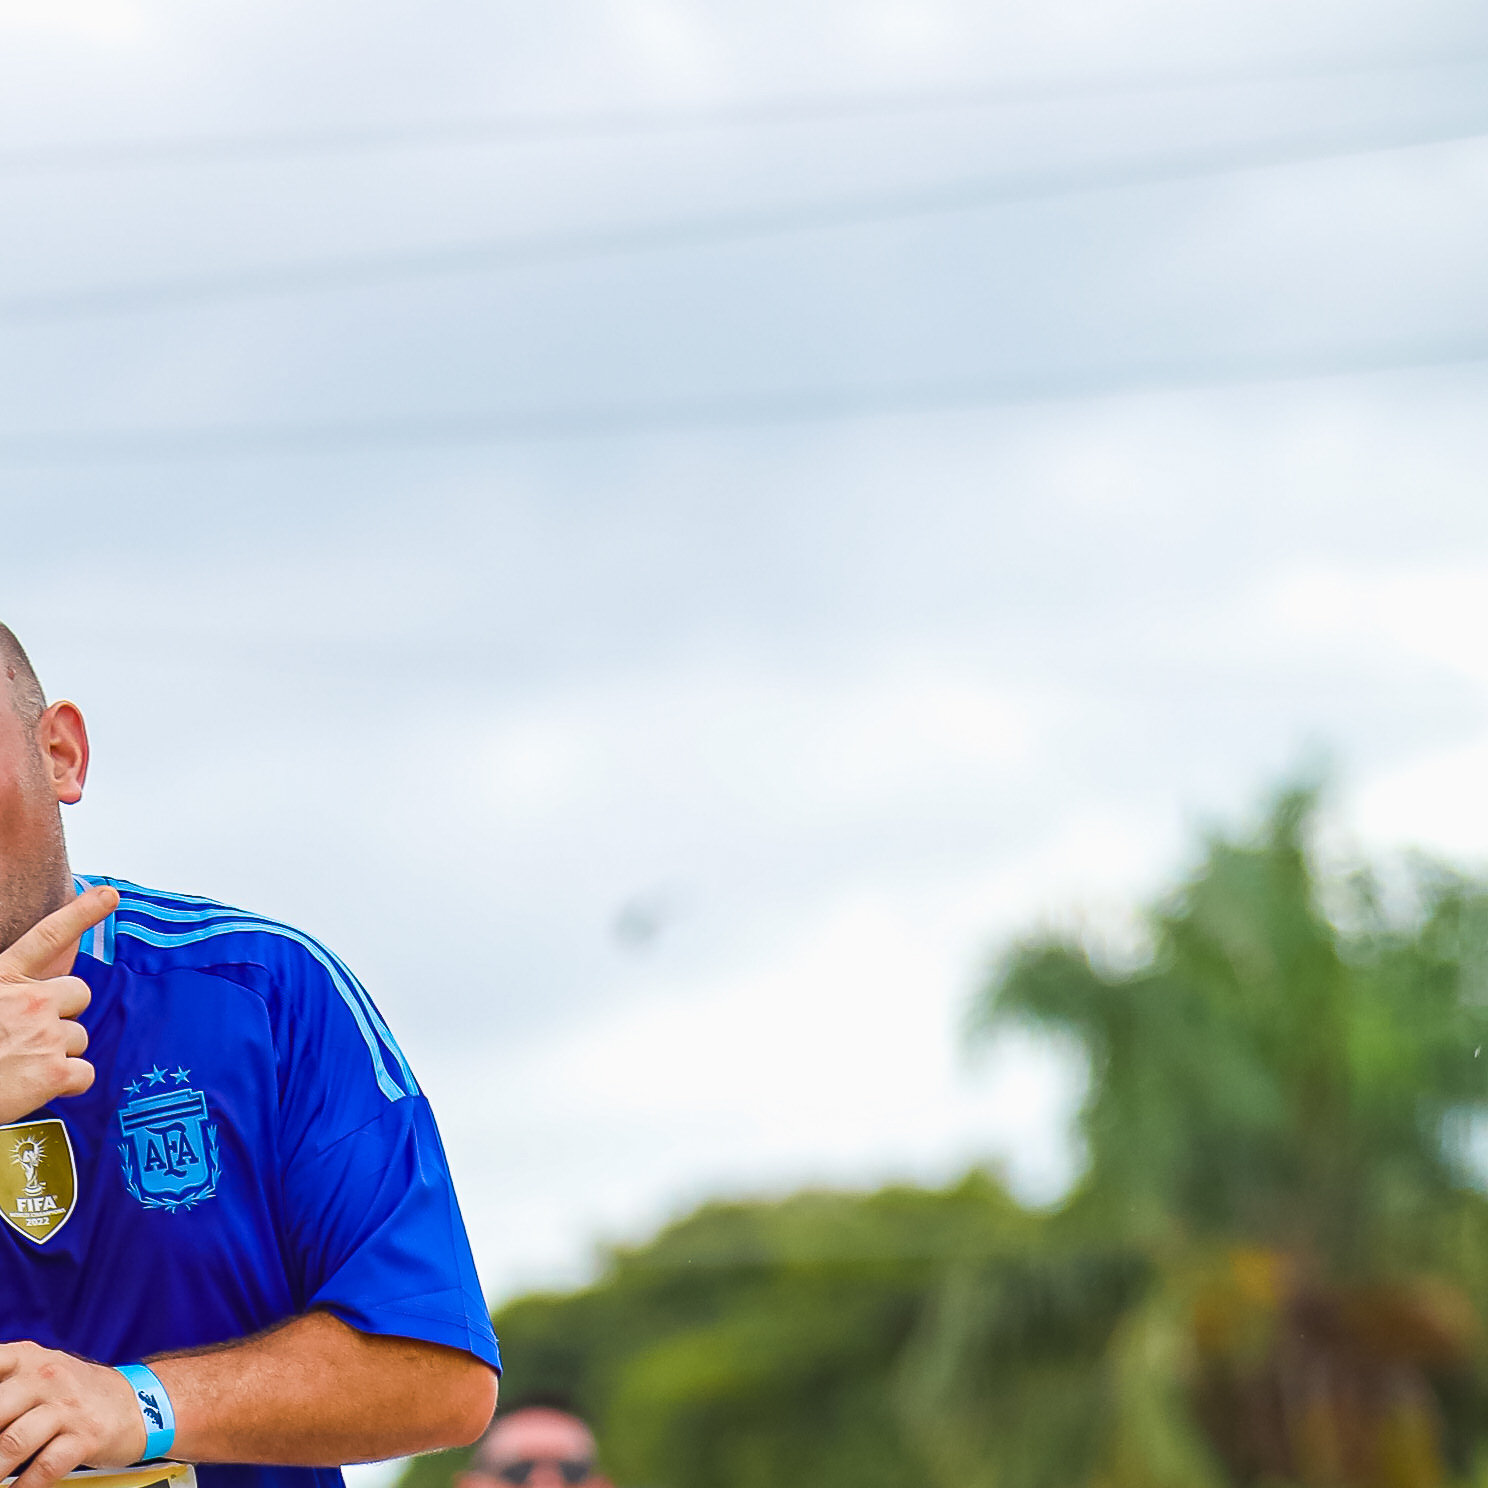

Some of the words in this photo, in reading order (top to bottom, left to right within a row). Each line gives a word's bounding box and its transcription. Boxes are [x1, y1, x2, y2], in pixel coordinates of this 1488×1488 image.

[144, 1121, 199, 1179] AFA
[16, 1196, 57, 1212] FIFA
[26, 1217, 50, 1226] 2022
